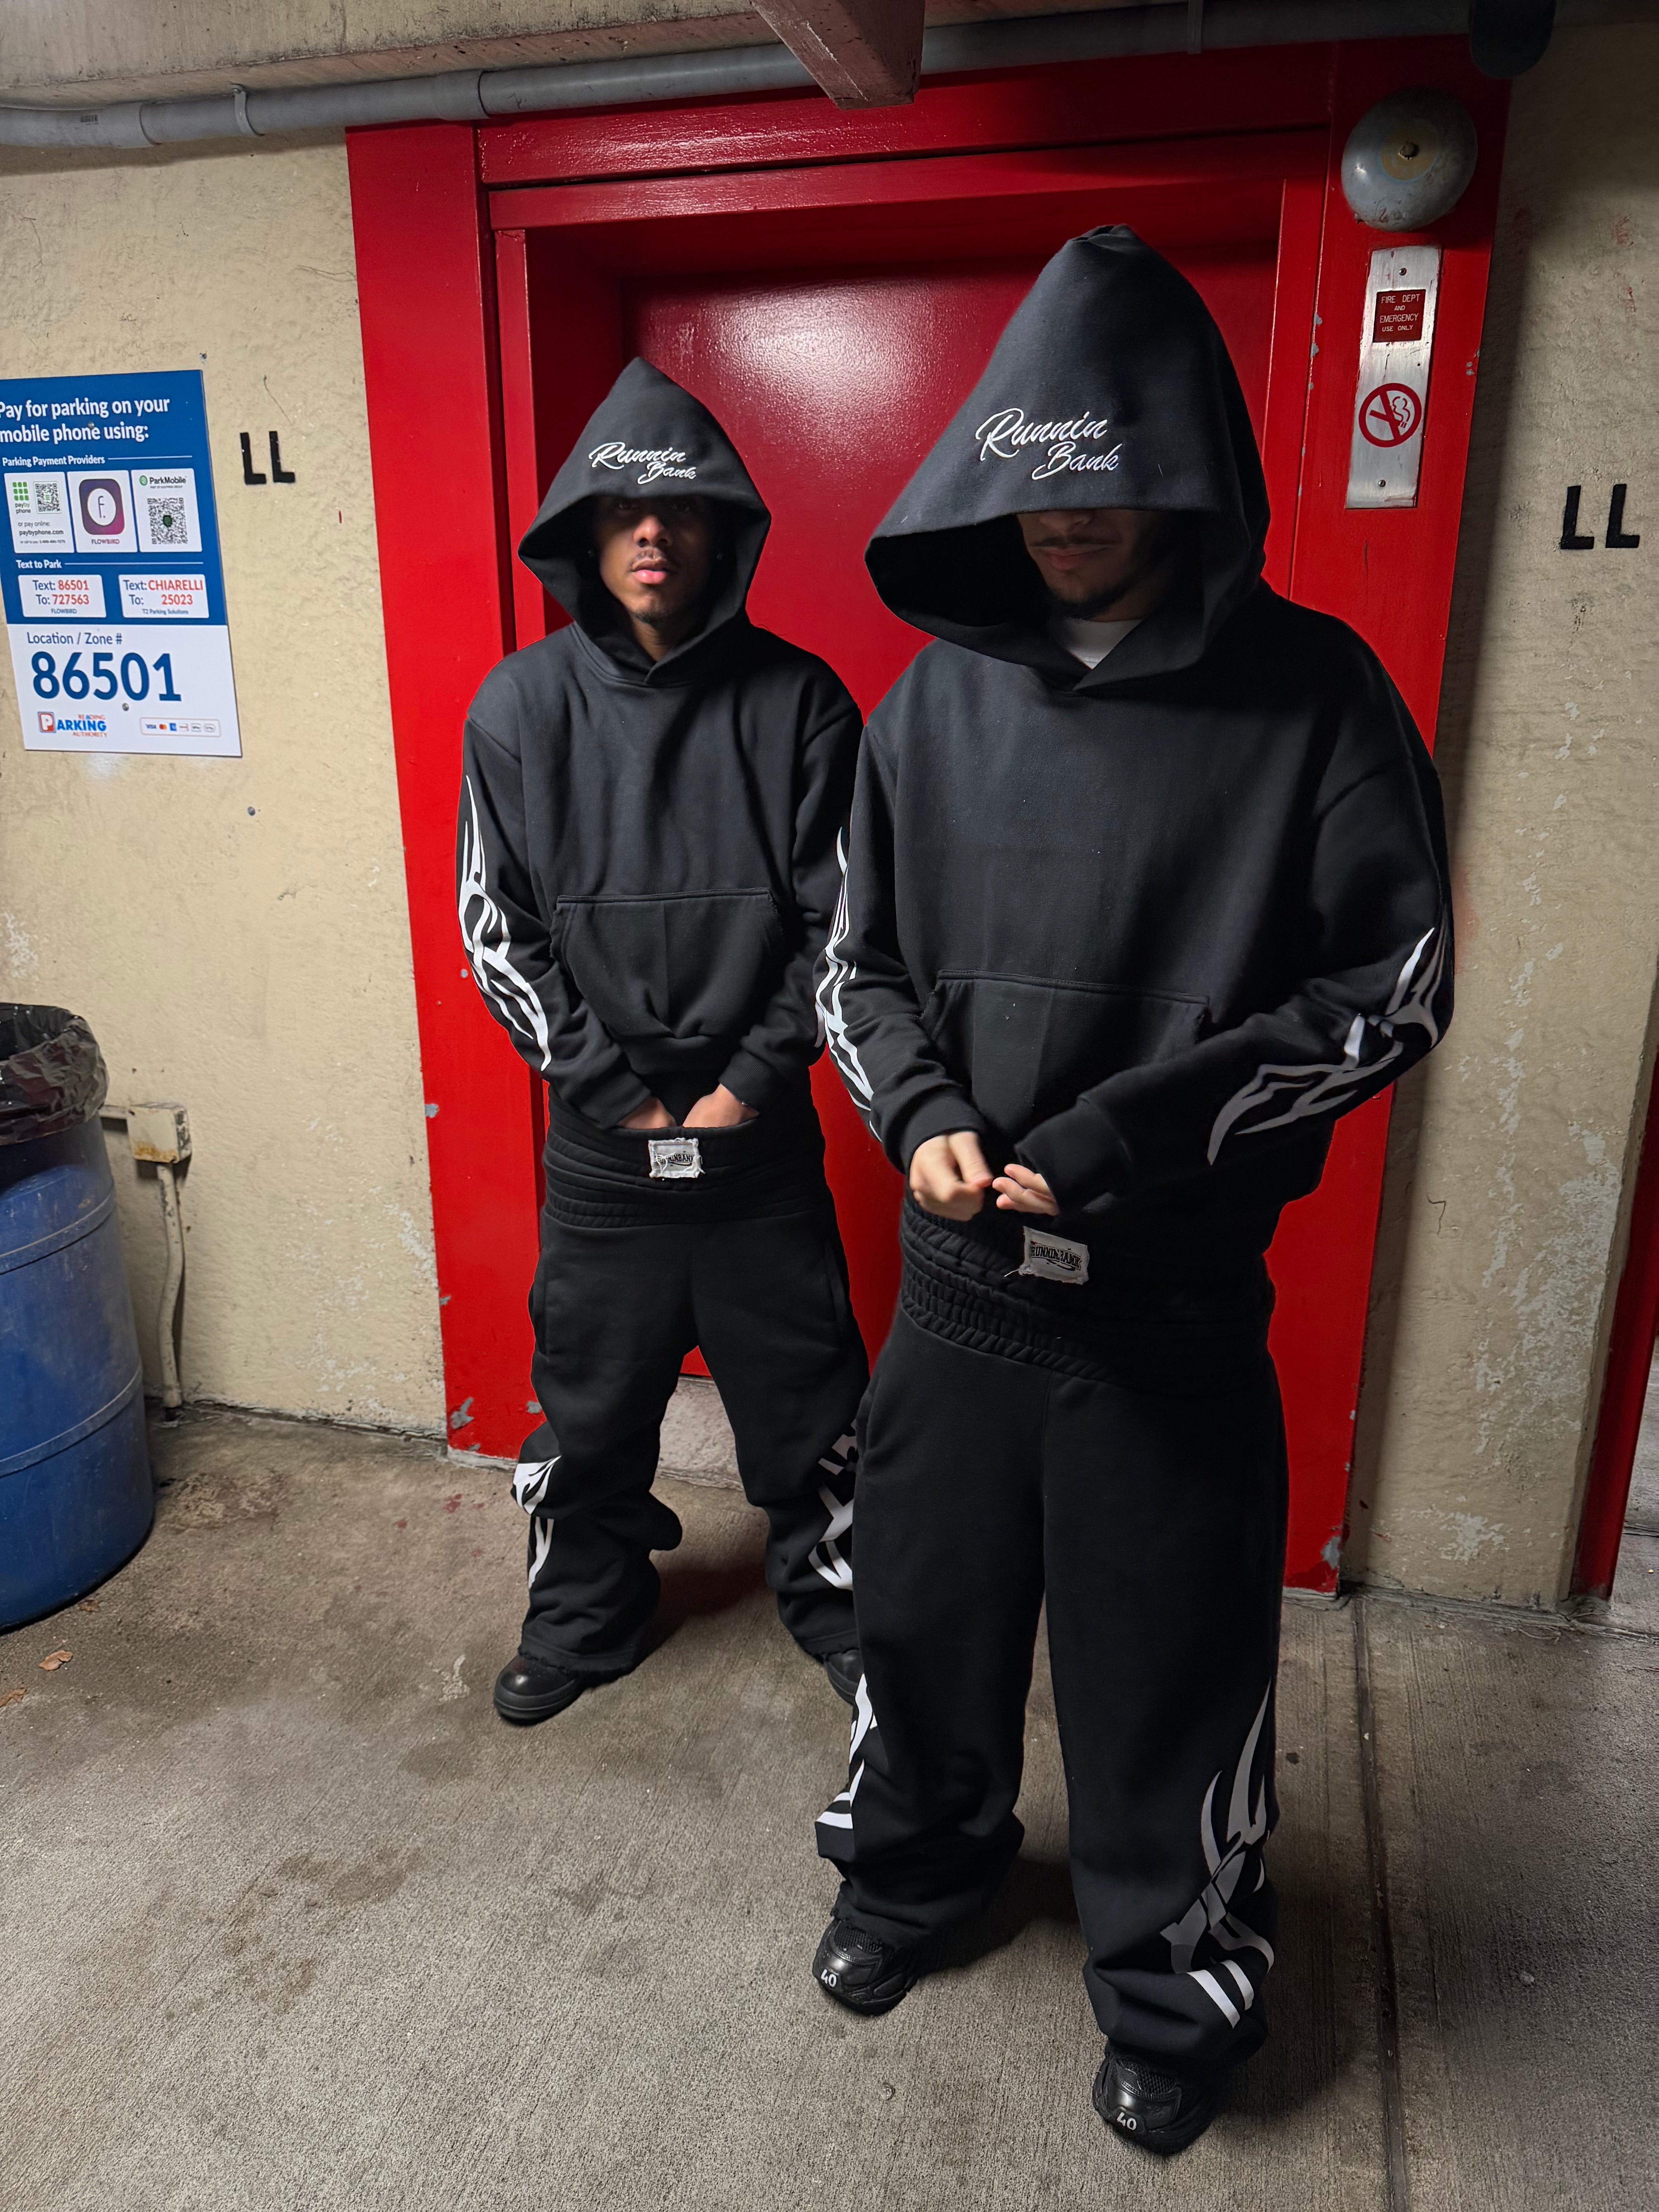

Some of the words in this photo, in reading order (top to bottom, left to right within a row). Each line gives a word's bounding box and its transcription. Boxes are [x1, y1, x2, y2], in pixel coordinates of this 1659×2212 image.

[1381, 295, 1396, 304] FIRE
[1402, 294, 1420, 302] DEPT
[1380, 313, 1419, 323] EMERGENCY
[25, 399, 48, 417] for
[51, 397, 109, 420] parking
[112, 400, 132, 414] on
[134, 398, 170, 417] your
[0, 424, 50, 443] mobile
[52, 423, 101, 445] phone
[103, 421, 149, 442] using:
[975, 407, 1108, 461] Runnin
[2, 456, 32, 468] Parking
[32, 455, 67, 467] Payment
[67, 454, 105, 465] Providers
[239, 431, 296, 485] LL
[588, 441, 686, 470] Runnin
[1032, 441, 1123, 480] Bank
[149, 476, 186, 484] ParkMobile
[637, 460, 697, 484] Bank
[1560, 483, 1640, 550] LL
[15, 560, 33, 568] Text
[34, 560, 43, 569] to
[43, 559, 62, 568] Park
[32, 580, 56, 591] Text:
[58, 579, 89, 591] 86501
[123, 580, 148, 591] Text:
[148, 579, 203, 591] CHIARELLI
[35, 594, 51, 605] To:
[52, 594, 89, 605] 727563
[128, 594, 144, 605] To:
[161, 594, 193, 605] 25023
[27, 632, 74, 645] Location
[77, 632, 81, 645] /
[84, 632, 113, 645] Zone
[115, 633, 123, 645] #
[31, 651, 182, 701] 86501
[820, 1968, 837, 1987] 40
[1116, 2112, 1137, 2130] 40
